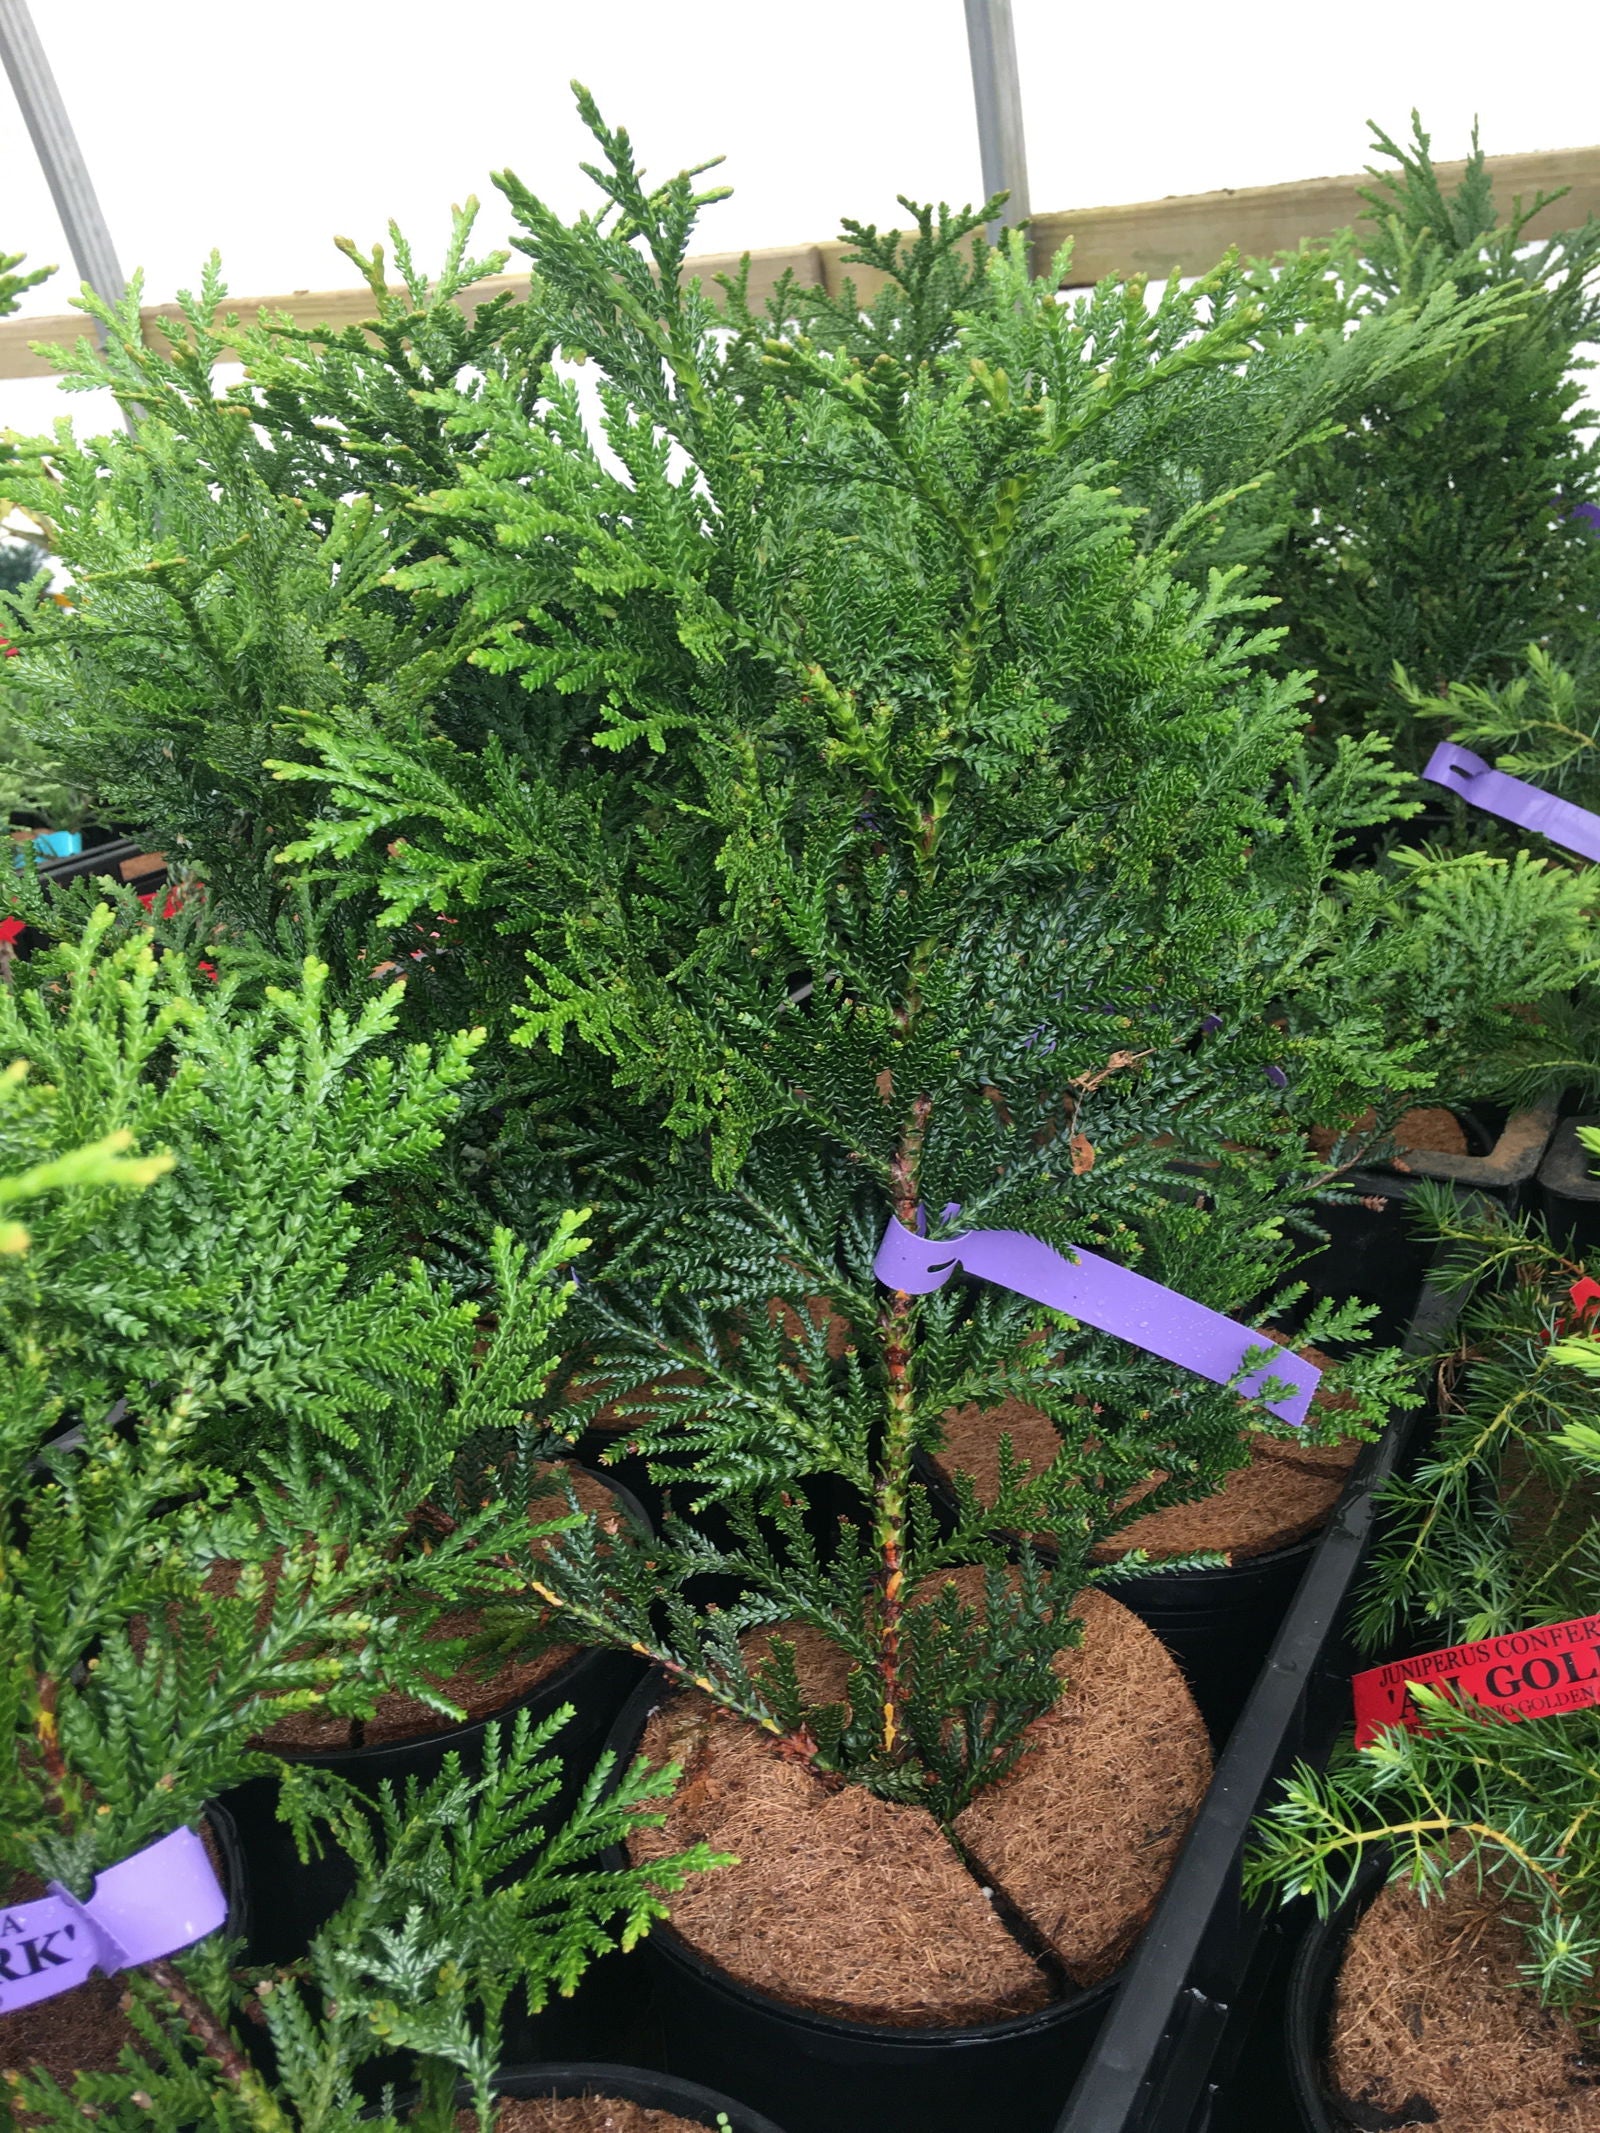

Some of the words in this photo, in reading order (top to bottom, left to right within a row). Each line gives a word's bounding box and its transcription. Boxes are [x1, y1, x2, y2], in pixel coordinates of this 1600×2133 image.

[1379, 1645, 1490, 1687] JUNIPERUS
[1495, 1619, 1600, 1658] CONFER
[1518, 1686, 1595, 1714] GOLDEN
[0, 1914, 25, 1938] A
